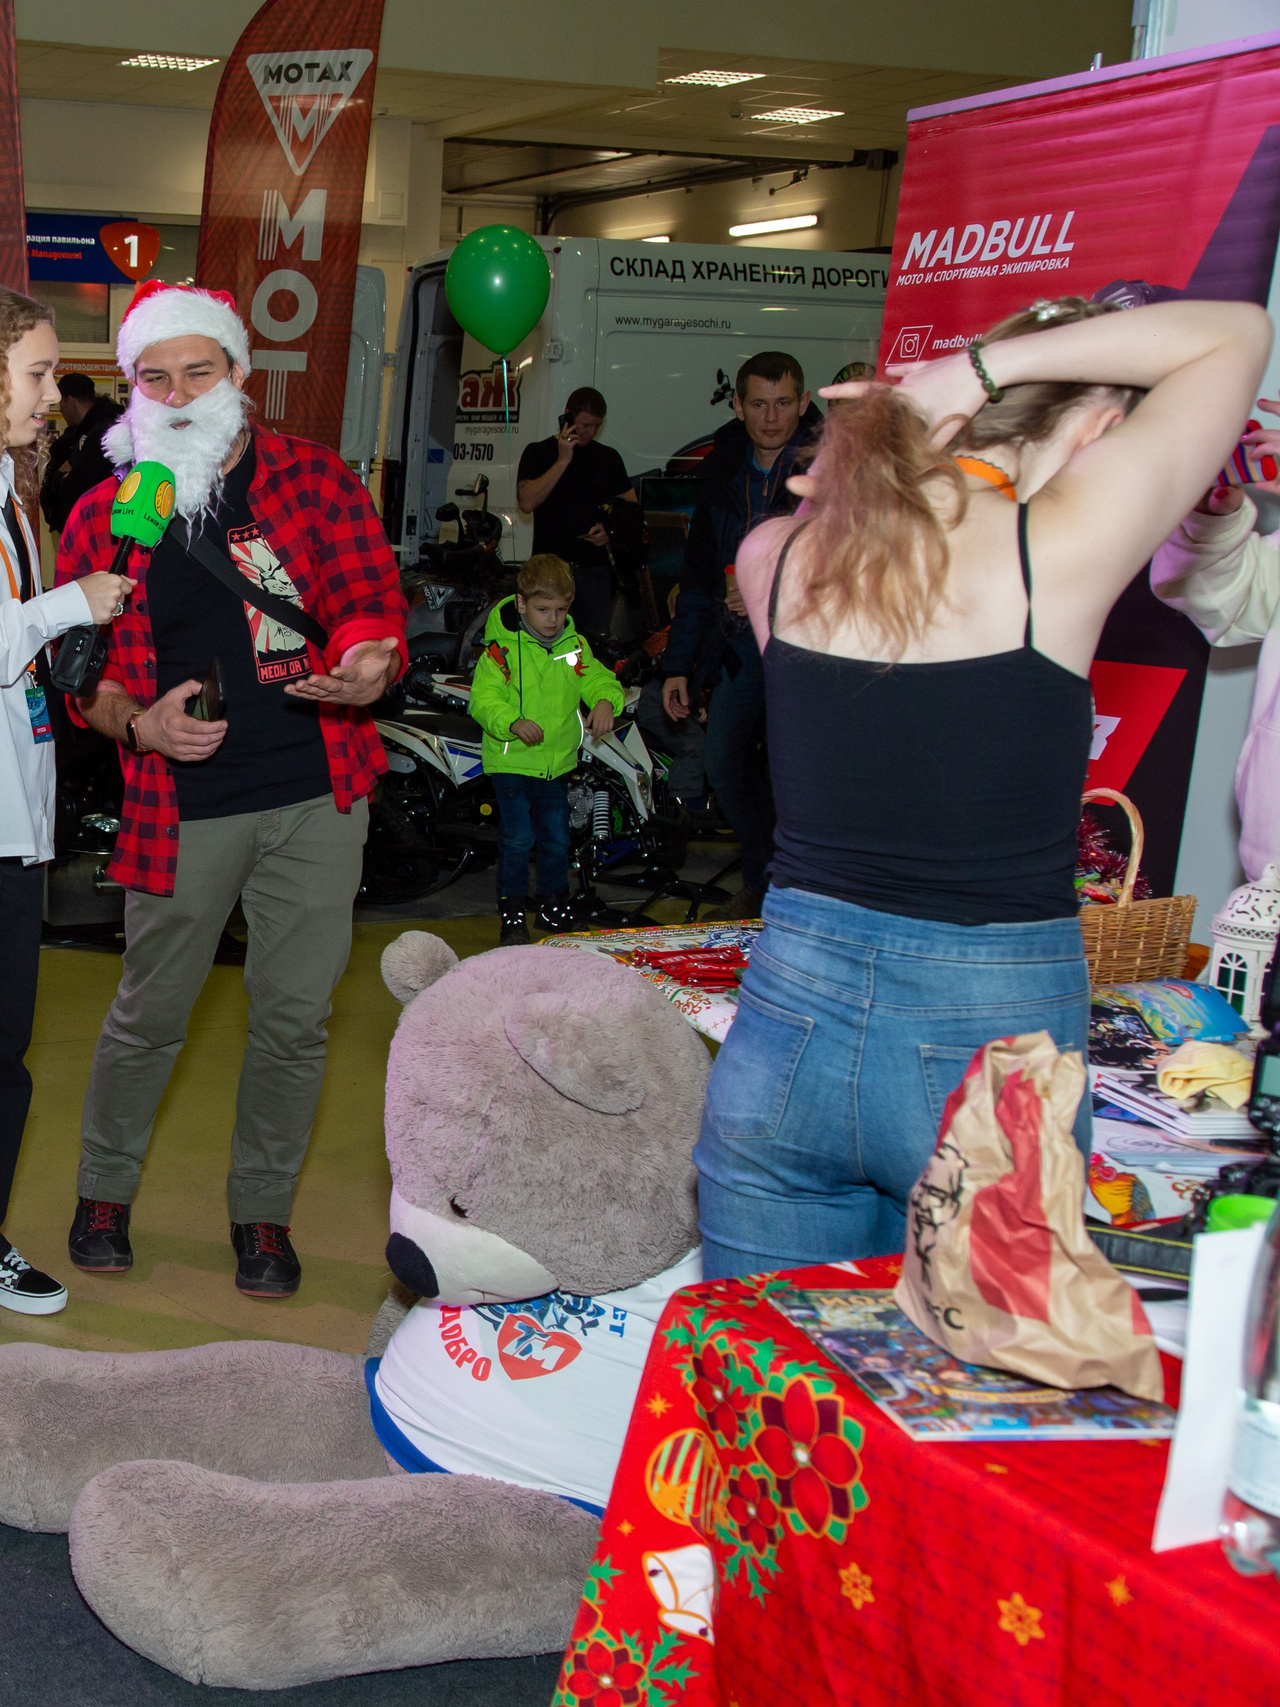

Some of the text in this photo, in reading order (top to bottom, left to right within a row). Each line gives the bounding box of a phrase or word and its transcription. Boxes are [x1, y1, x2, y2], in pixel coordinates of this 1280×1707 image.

[262, 60, 354, 85] MOTAX
[51, 235, 95, 245] павильона
[124, 235, 138, 267] 1
[901, 210, 1075, 271] MADBULL
[31, 249, 82, 260] Management
[610, 256, 686, 283] СКЛАД
[691, 260, 806, 285] ХРАНЕНИЯ
[896, 257, 1070, 286] МОТО И СПОРТИВНАЯ ЭКИПИРОВКА
[248, 188, 328, 421] MOT
[615, 316, 731, 330] www.mygaragesochi.ru
[453, 443, 494, 461] 03-7570
[260, 663, 288, 680] MEOW
[438, 1304, 492, 1382] ДОБРО
